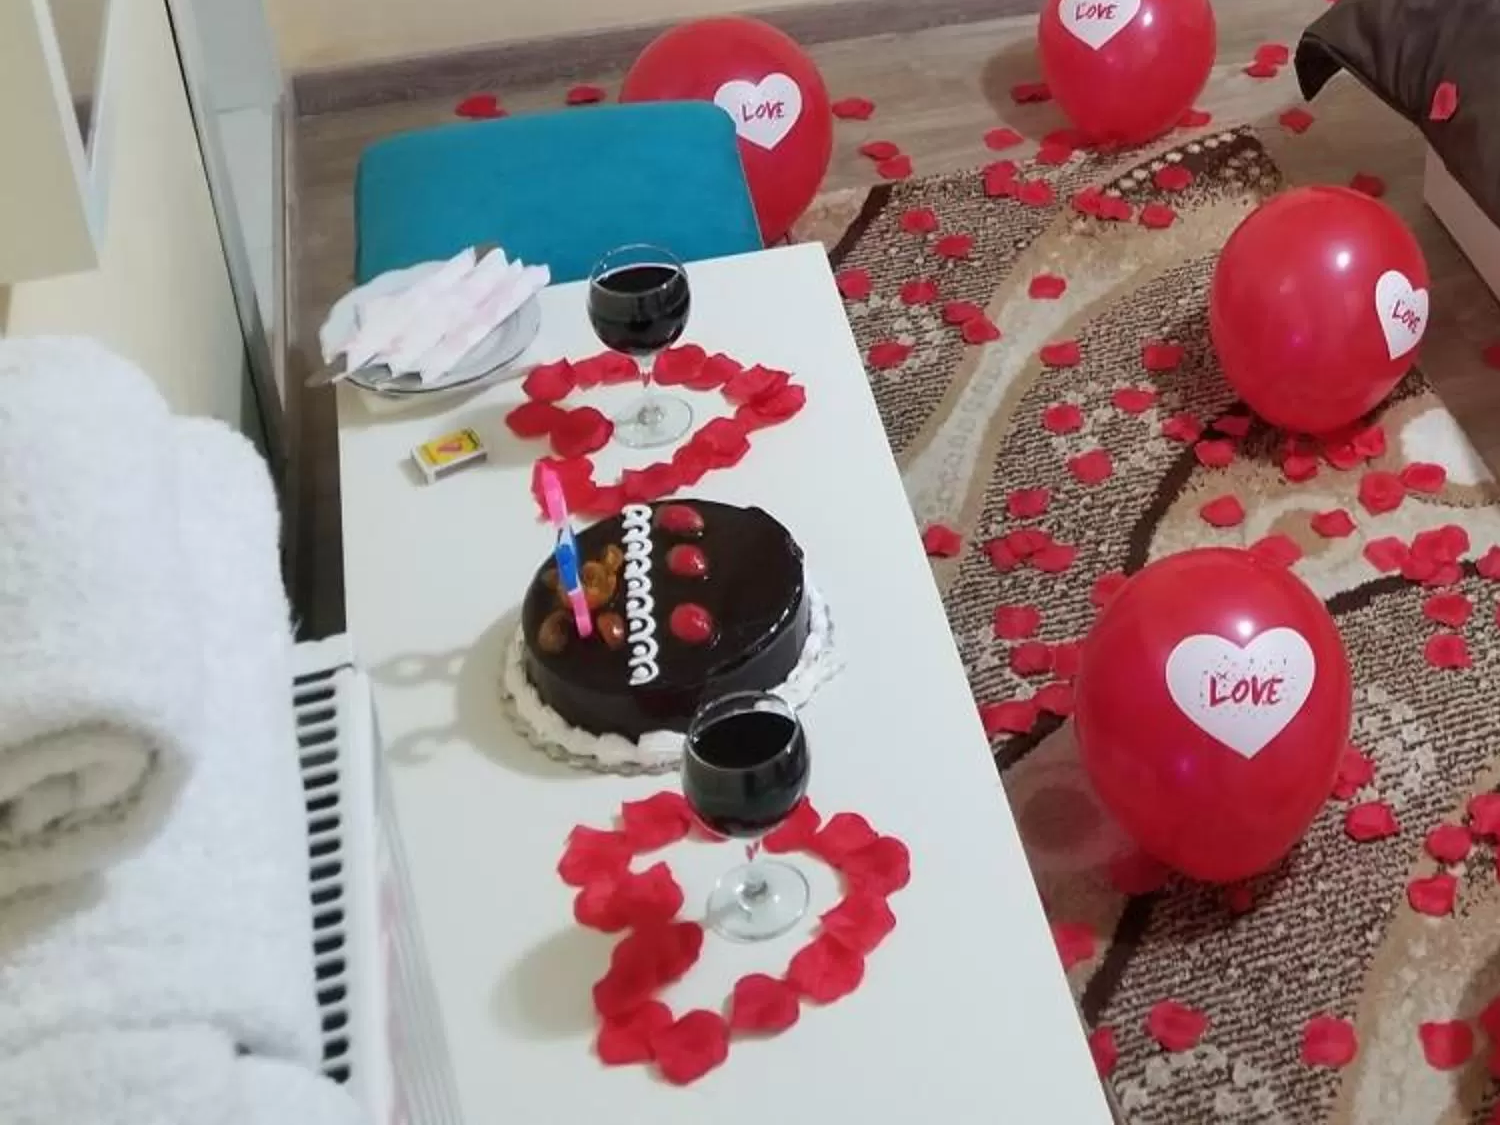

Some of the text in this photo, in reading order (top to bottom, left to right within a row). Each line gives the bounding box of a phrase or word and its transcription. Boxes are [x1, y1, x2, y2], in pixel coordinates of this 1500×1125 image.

[1074, 2, 1117, 21] LOVE
[742, 101, 785, 123] LOVE
[1391, 299, 1421, 335] LOVE
[1209, 673, 1284, 707] LOVE
